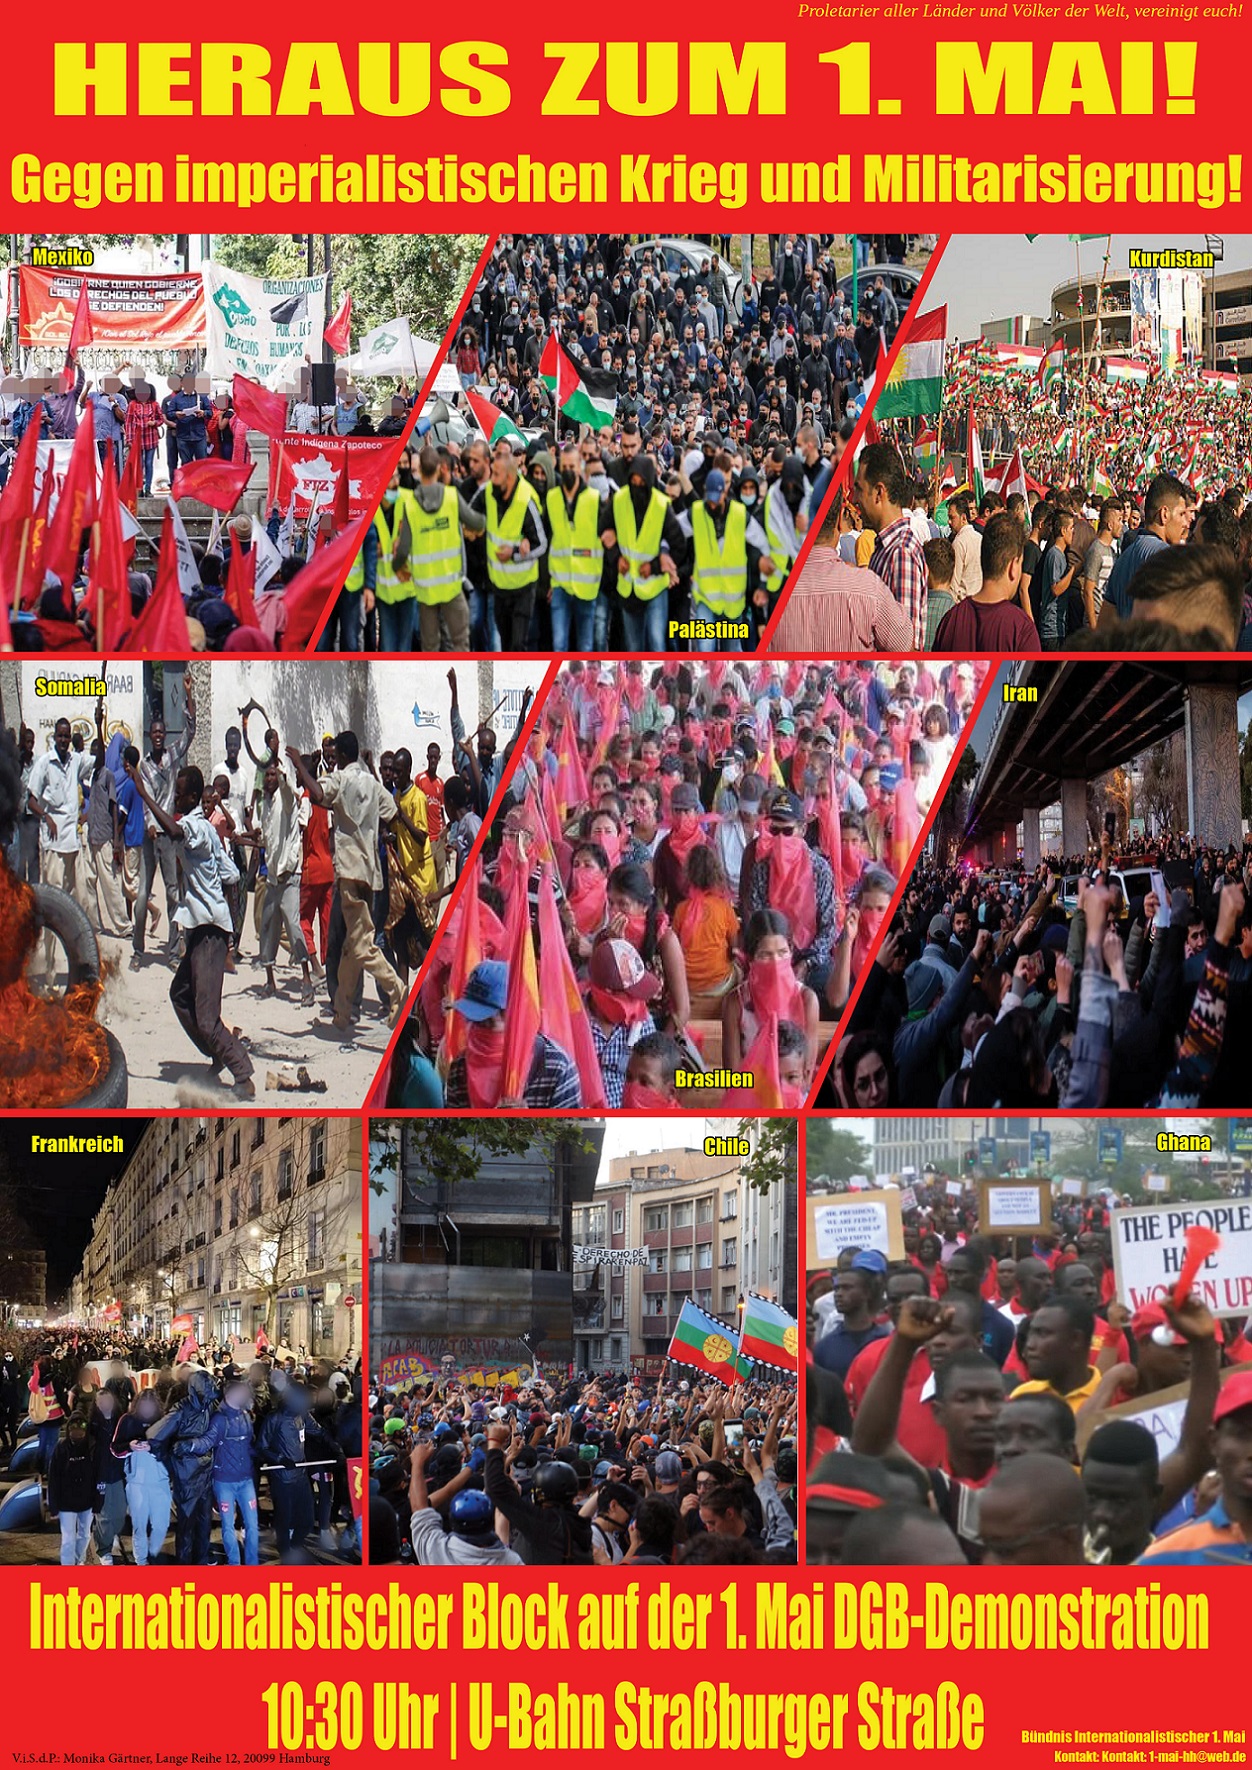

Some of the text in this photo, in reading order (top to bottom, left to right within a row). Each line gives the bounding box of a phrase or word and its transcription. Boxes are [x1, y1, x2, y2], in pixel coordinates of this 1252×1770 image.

[798, 4, 1243, 21] Proletarier aller Länder und Völker der Welt, vereinigt euch!
[55, 41, 1197, 116] HERAUS ZUM 1. MAI!
[12, 154, 1242, 208] Gegen imperialistischen Krieg und Militarisierung!
[50, 288, 72, 298] LOS
[73, 290, 131, 300] DRECHOS
[132, 291, 154, 300] DEL
[101, 302, 164, 312] DEFIENDEN!
[302, 437, 339, 449] Indígena
[1120, 1205, 1252, 1243] THE PEOPLE
[583, 1247, 630, 1259] DERECHO
[632, 1247, 643, 1257] DE
[1223, 1276, 1252, 1309] UP
[382, 1357, 425, 1381] ACAB
[31, 1581, 1208, 1650] Internationalistischer Block auf der 1. Mai DGB-Demonstration
[262, 1681, 362, 1750] 10:30
[374, 1683, 438, 1750] Uhr
[470, 1683, 604, 1750] U-Bahn
[615, 1681, 848, 1758] Straßburger
[858, 1681, 984, 1750] Straße
[1022, 1730, 1246, 1743] Bündnis Internationalistischer 1. Mai
[64, 1753, 105, 1764] Monika
[108, 1753, 152, 1765] Gärtner,
[156, 1753, 188, 1767] Lange
[192, 1753, 221, 1764] Reihe
[226, 1753, 240, 1765] 12,
[244, 1753, 275, 1764] 20099
[279, 1753, 330, 1767] Hamburg
[1055, 1751, 1247, 1763] Kontakt: Kontakt: 1-mai-hh@web.de
